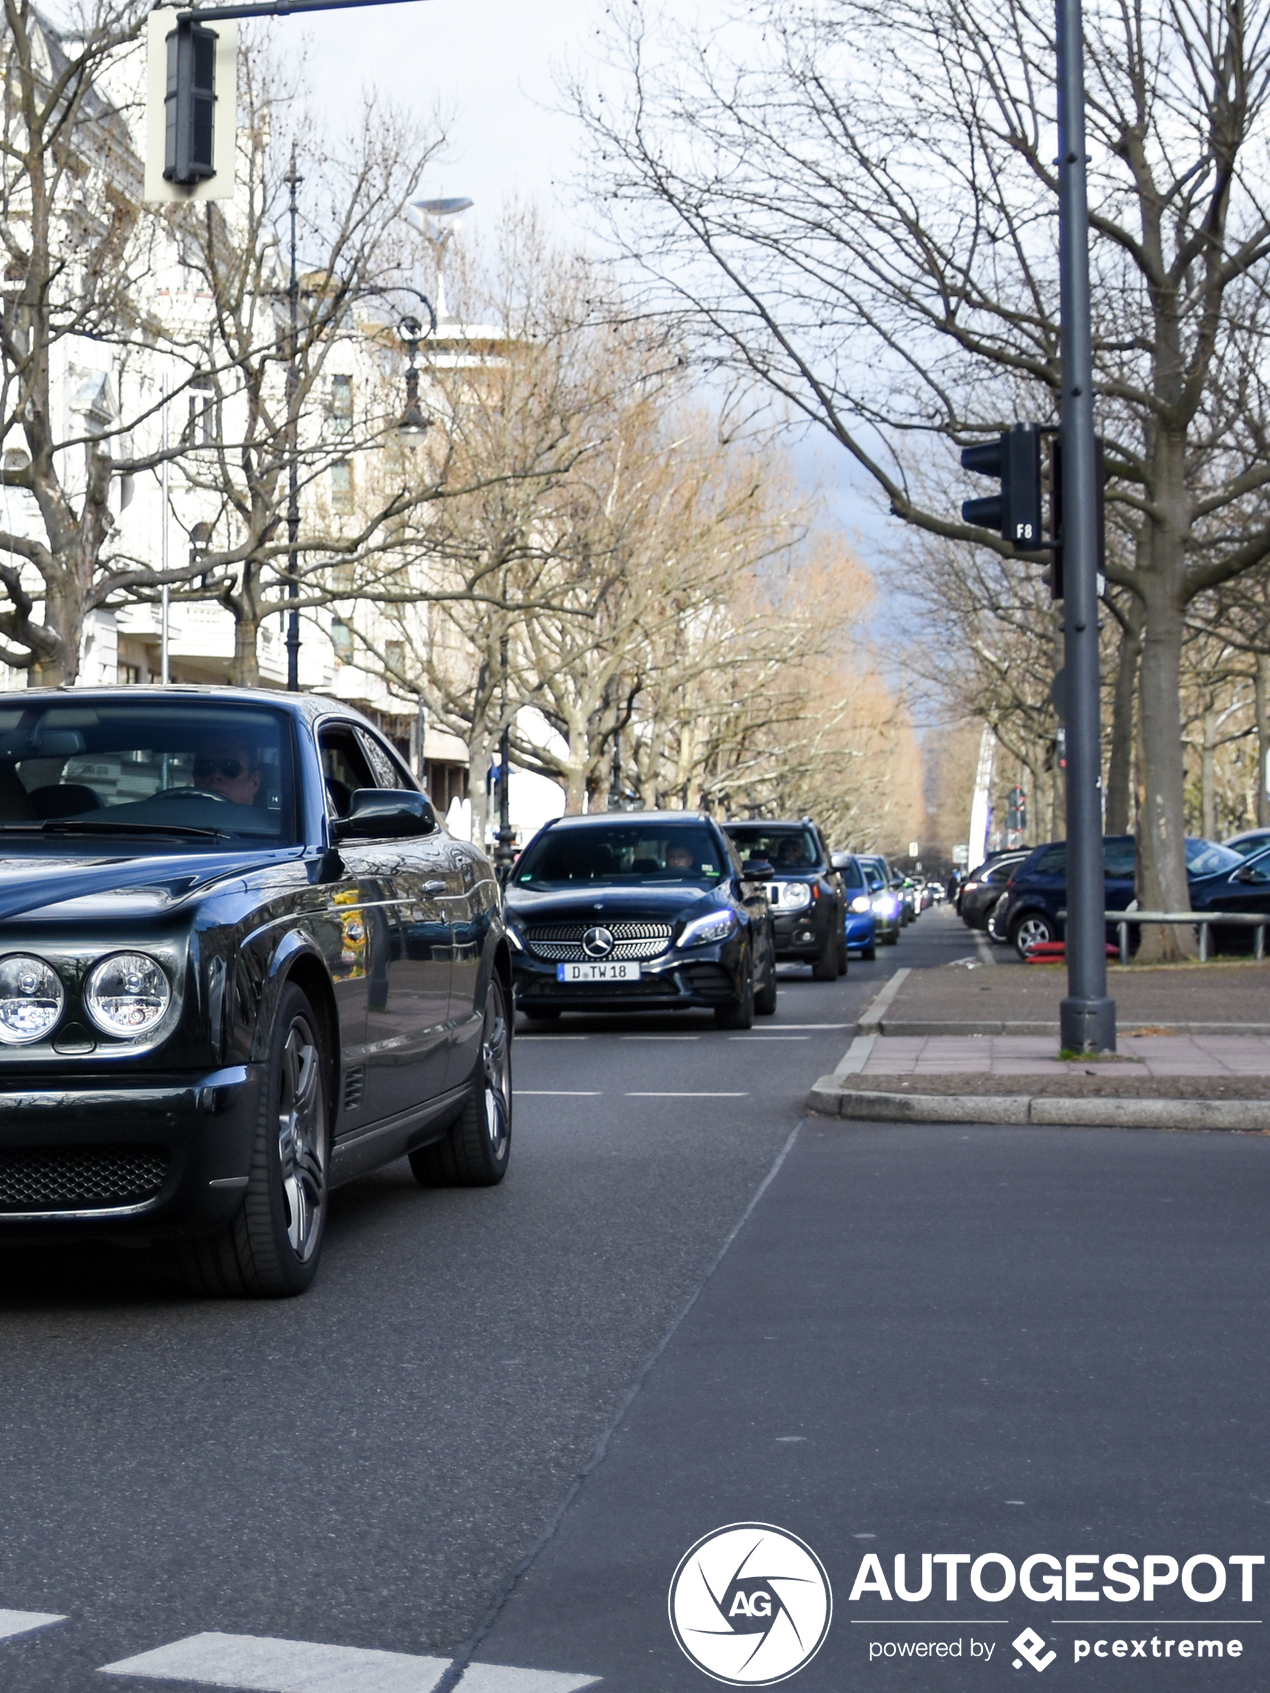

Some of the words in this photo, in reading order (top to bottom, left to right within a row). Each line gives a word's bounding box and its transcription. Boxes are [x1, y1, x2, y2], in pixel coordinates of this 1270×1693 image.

[572, 966, 581, 979] D
[590, 965, 607, 979] TW
[610, 965, 627, 978] 18
